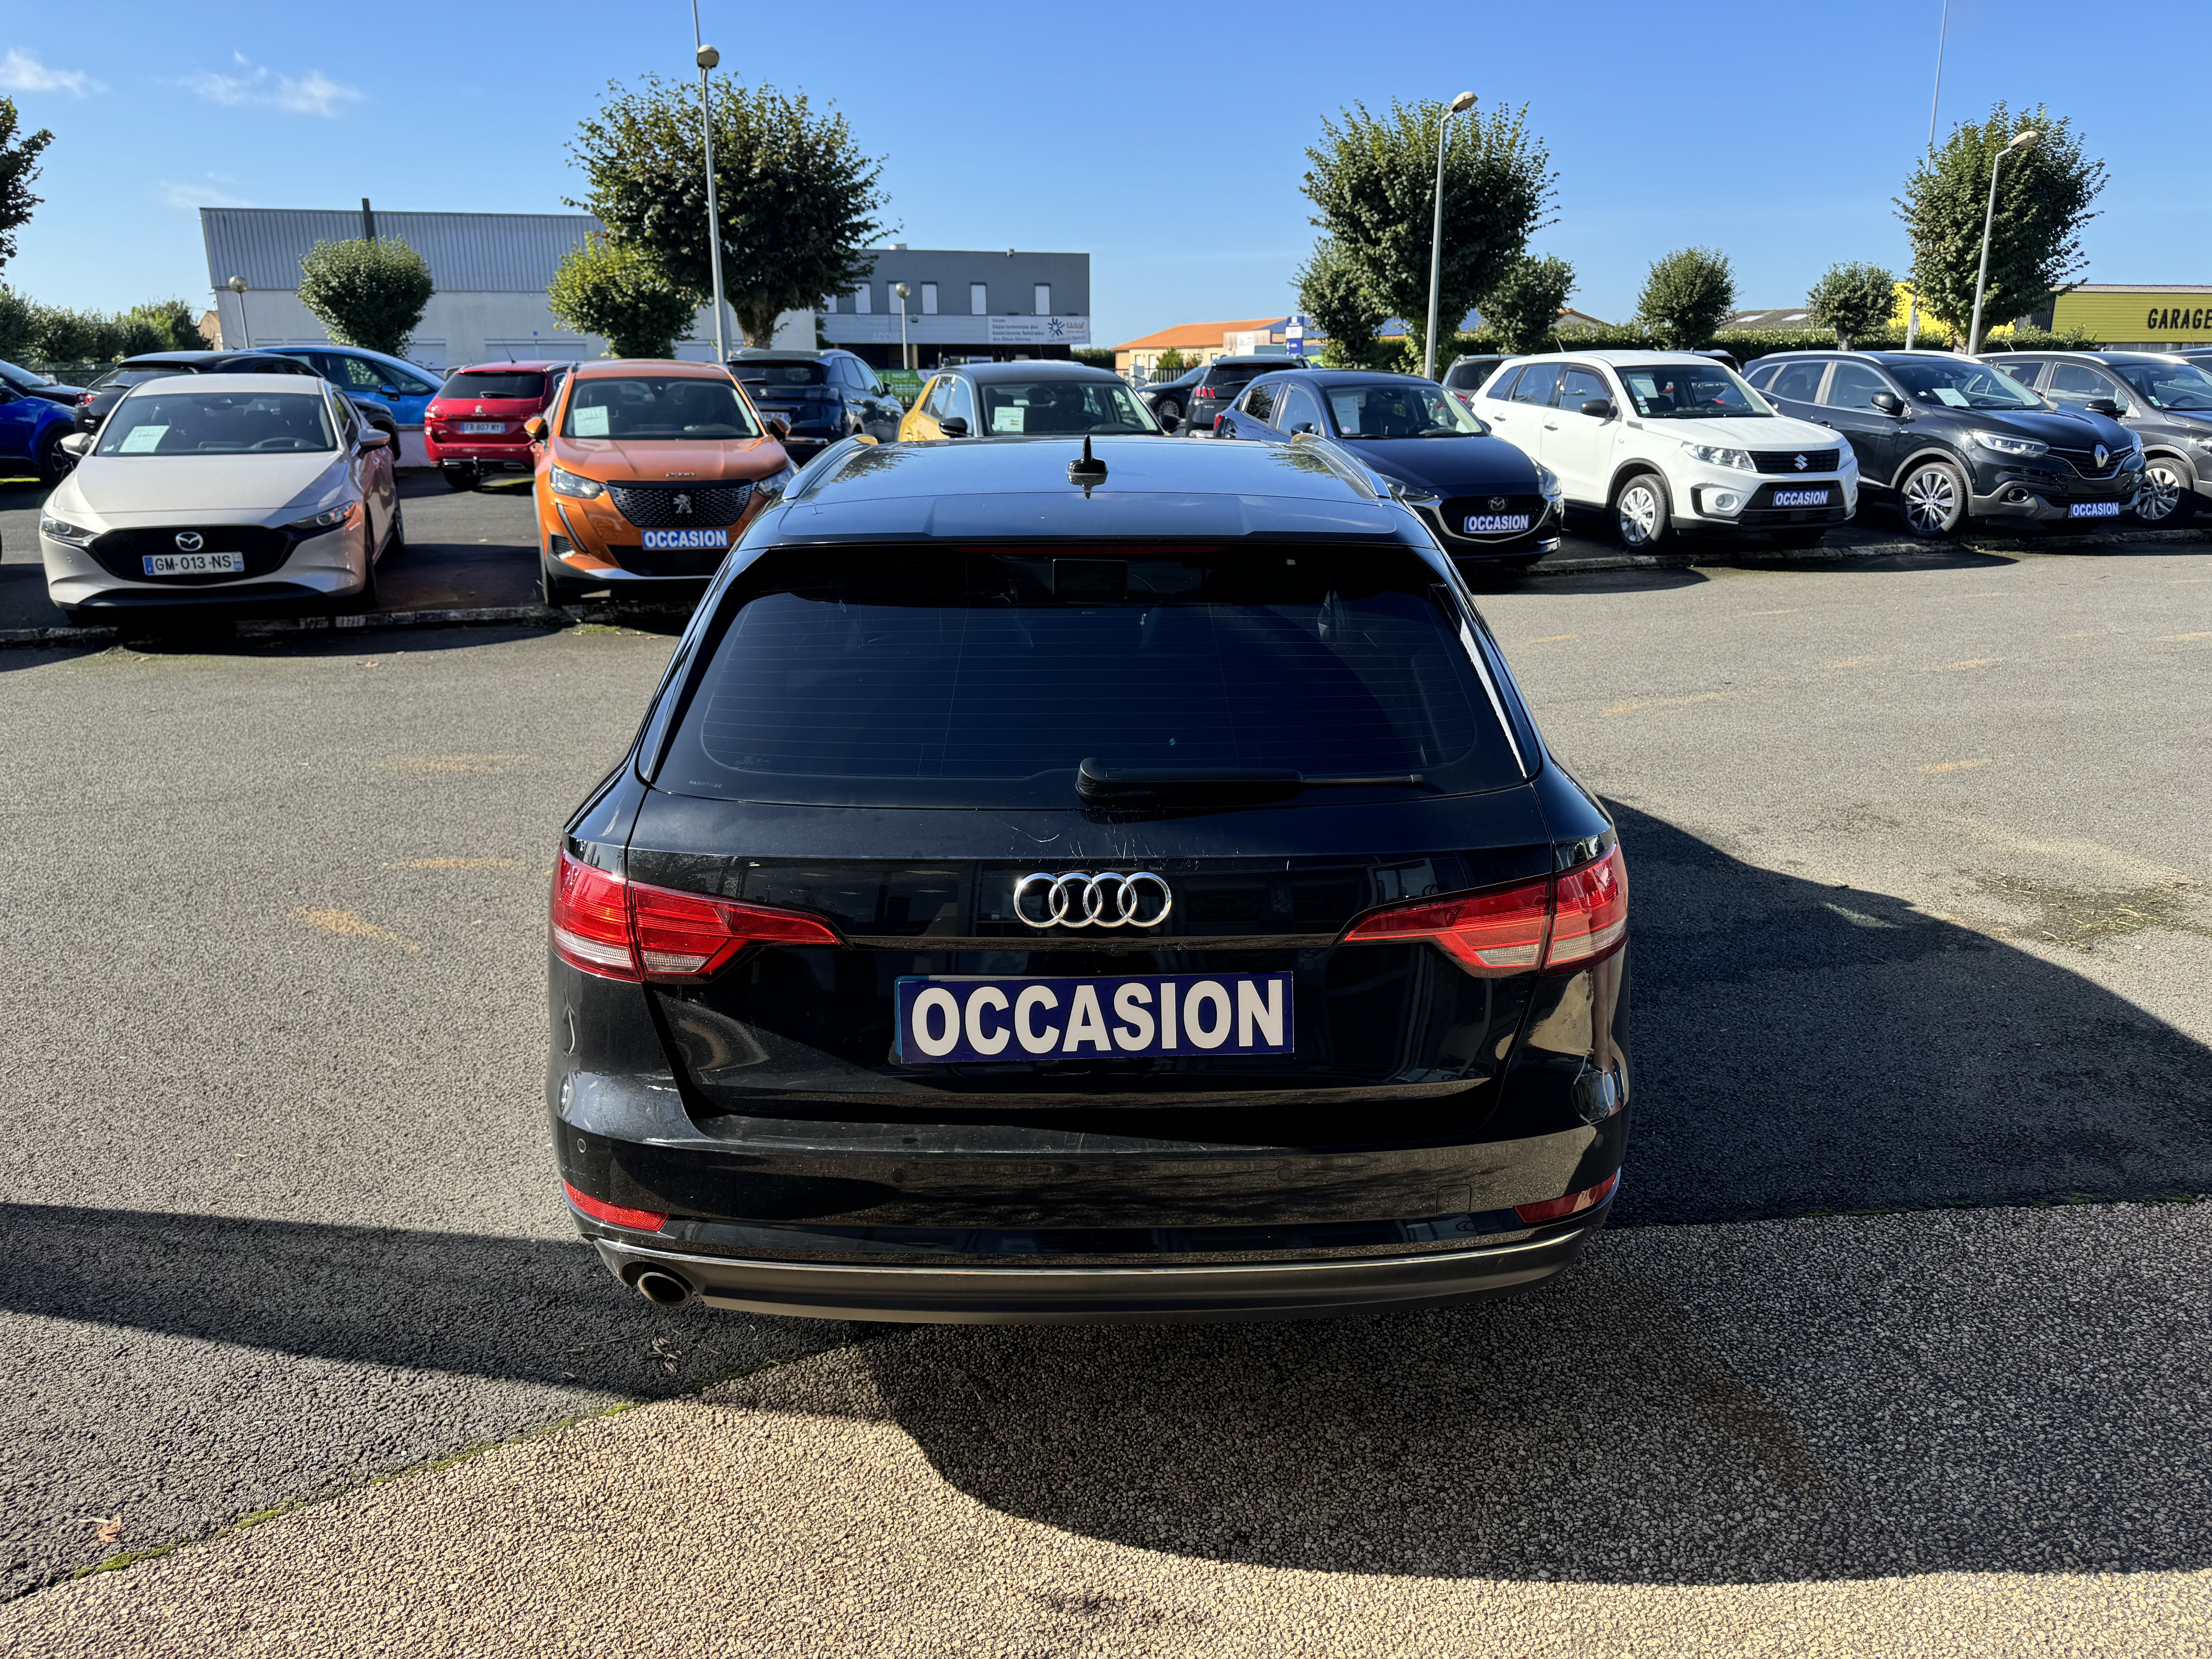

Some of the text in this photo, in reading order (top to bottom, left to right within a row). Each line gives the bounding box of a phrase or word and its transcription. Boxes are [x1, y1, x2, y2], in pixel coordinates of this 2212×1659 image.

[2148, 308, 2212, 329] GARAGE
[1776, 490, 1829, 505] OCCASION
[2073, 502, 2119, 516] OCCASION
[1468, 514, 1529, 531] OCCASION
[644, 530, 727, 548] OCCASION
[912, 980, 1283, 1056] OCCASION
